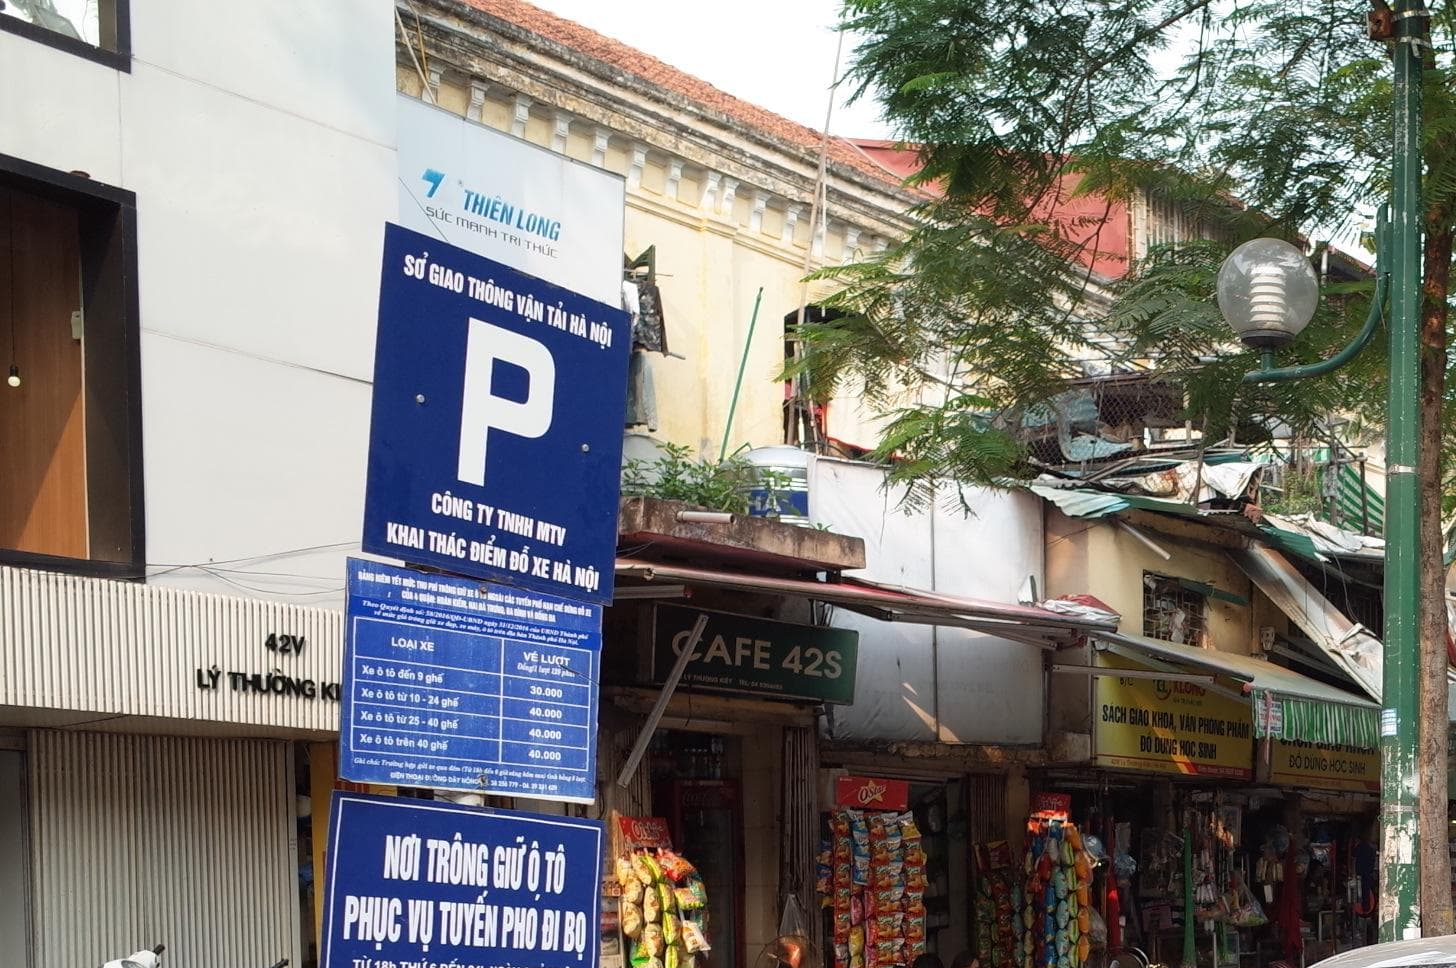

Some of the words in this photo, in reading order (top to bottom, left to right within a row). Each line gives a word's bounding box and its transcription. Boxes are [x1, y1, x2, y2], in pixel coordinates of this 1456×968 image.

[463, 189, 515, 226] THIÊN
[516, 209, 561, 242] LONG
[425, 206, 453, 224] SỨC
[524, 240, 560, 259] THỨC
[403, 252, 429, 280] SỞ
[429, 263, 464, 294] GIAO
[467, 278, 514, 312] THÔNG
[516, 294, 544, 323] VẬN
[547, 301, 567, 331] TẢI
[569, 313, 587, 339] HÀ
[590, 322, 613, 350] NỘI
[457, 317, 556, 487] P
[431, 491, 473, 521] CÔNG
[477, 503, 494, 527] TY
[497, 509, 533, 538] TNHH
[536, 520, 566, 547] MTV
[387, 522, 424, 550] KHAI
[428, 531, 467, 559] THÁC
[470, 535, 506, 569] ĐIỂM
[509, 546, 530, 573] ĐỖ
[532, 556, 550, 579] XE
[552, 558, 572, 585] HÀ
[574, 565, 599, 593] NỘI
[265, 633, 305, 657] 42V
[391, 637, 417, 650] LOẠI
[420, 641, 435, 652] XE
[523, 651, 538, 662] VÉ
[541, 654, 571, 667] LƯỢT
[671, 630, 771, 670] CAFE
[781, 646, 842, 680] 42S
[197, 664, 221, 690] LÝ
[227, 669, 316, 700] THƯỜNG
[321, 681, 342, 702] KI
[362, 665, 374, 675] Xe
[377, 667, 383, 676] ô
[386, 668, 395, 678] tô
[398, 669, 415, 679] đến
[418, 672, 423, 680] 9
[426, 673, 444, 684] ghế
[361, 688, 374, 698] Xe
[376, 690, 383, 699] ô
[385, 691, 395, 700] tô
[397, 692, 407, 701] từ
[410, 694, 420, 703] 10
[428, 696, 439, 704] 24
[441, 697, 459, 708] ghế
[530, 686, 563, 698] 30.000
[360, 711, 373, 721] Xe
[376, 712, 382, 721] ô
[384, 713, 394, 723] tô
[396, 714, 407, 724] từ
[409, 716, 420, 725] 25
[427, 719, 439, 727] 40
[441, 719, 459, 730] ghế
[529, 707, 563, 719] 40.000
[360, 734, 373, 744] Xe
[375, 735, 381, 745] ô
[384, 736, 394, 746] tô
[396, 737, 415, 748] trên
[417, 740, 429, 749] 40
[430, 740, 449, 752] ghế
[528, 728, 562, 740] 40.000
[528, 750, 561, 761] 40.000
[1198, 742, 1217, 760] SINH
[1349, 761, 1366, 775] SINH
[384, 834, 421, 881] NƠI
[426, 832, 488, 887] TRÔNG
[493, 836, 527, 890] GIỮ
[527, 841, 540, 892] Ô
[545, 844, 566, 894] TÔ
[343, 895, 402, 951] PHỤC
[408, 899, 434, 952] VỤ
[439, 890, 499, 948] TUYẾN
[541, 909, 561, 951] ĐI
